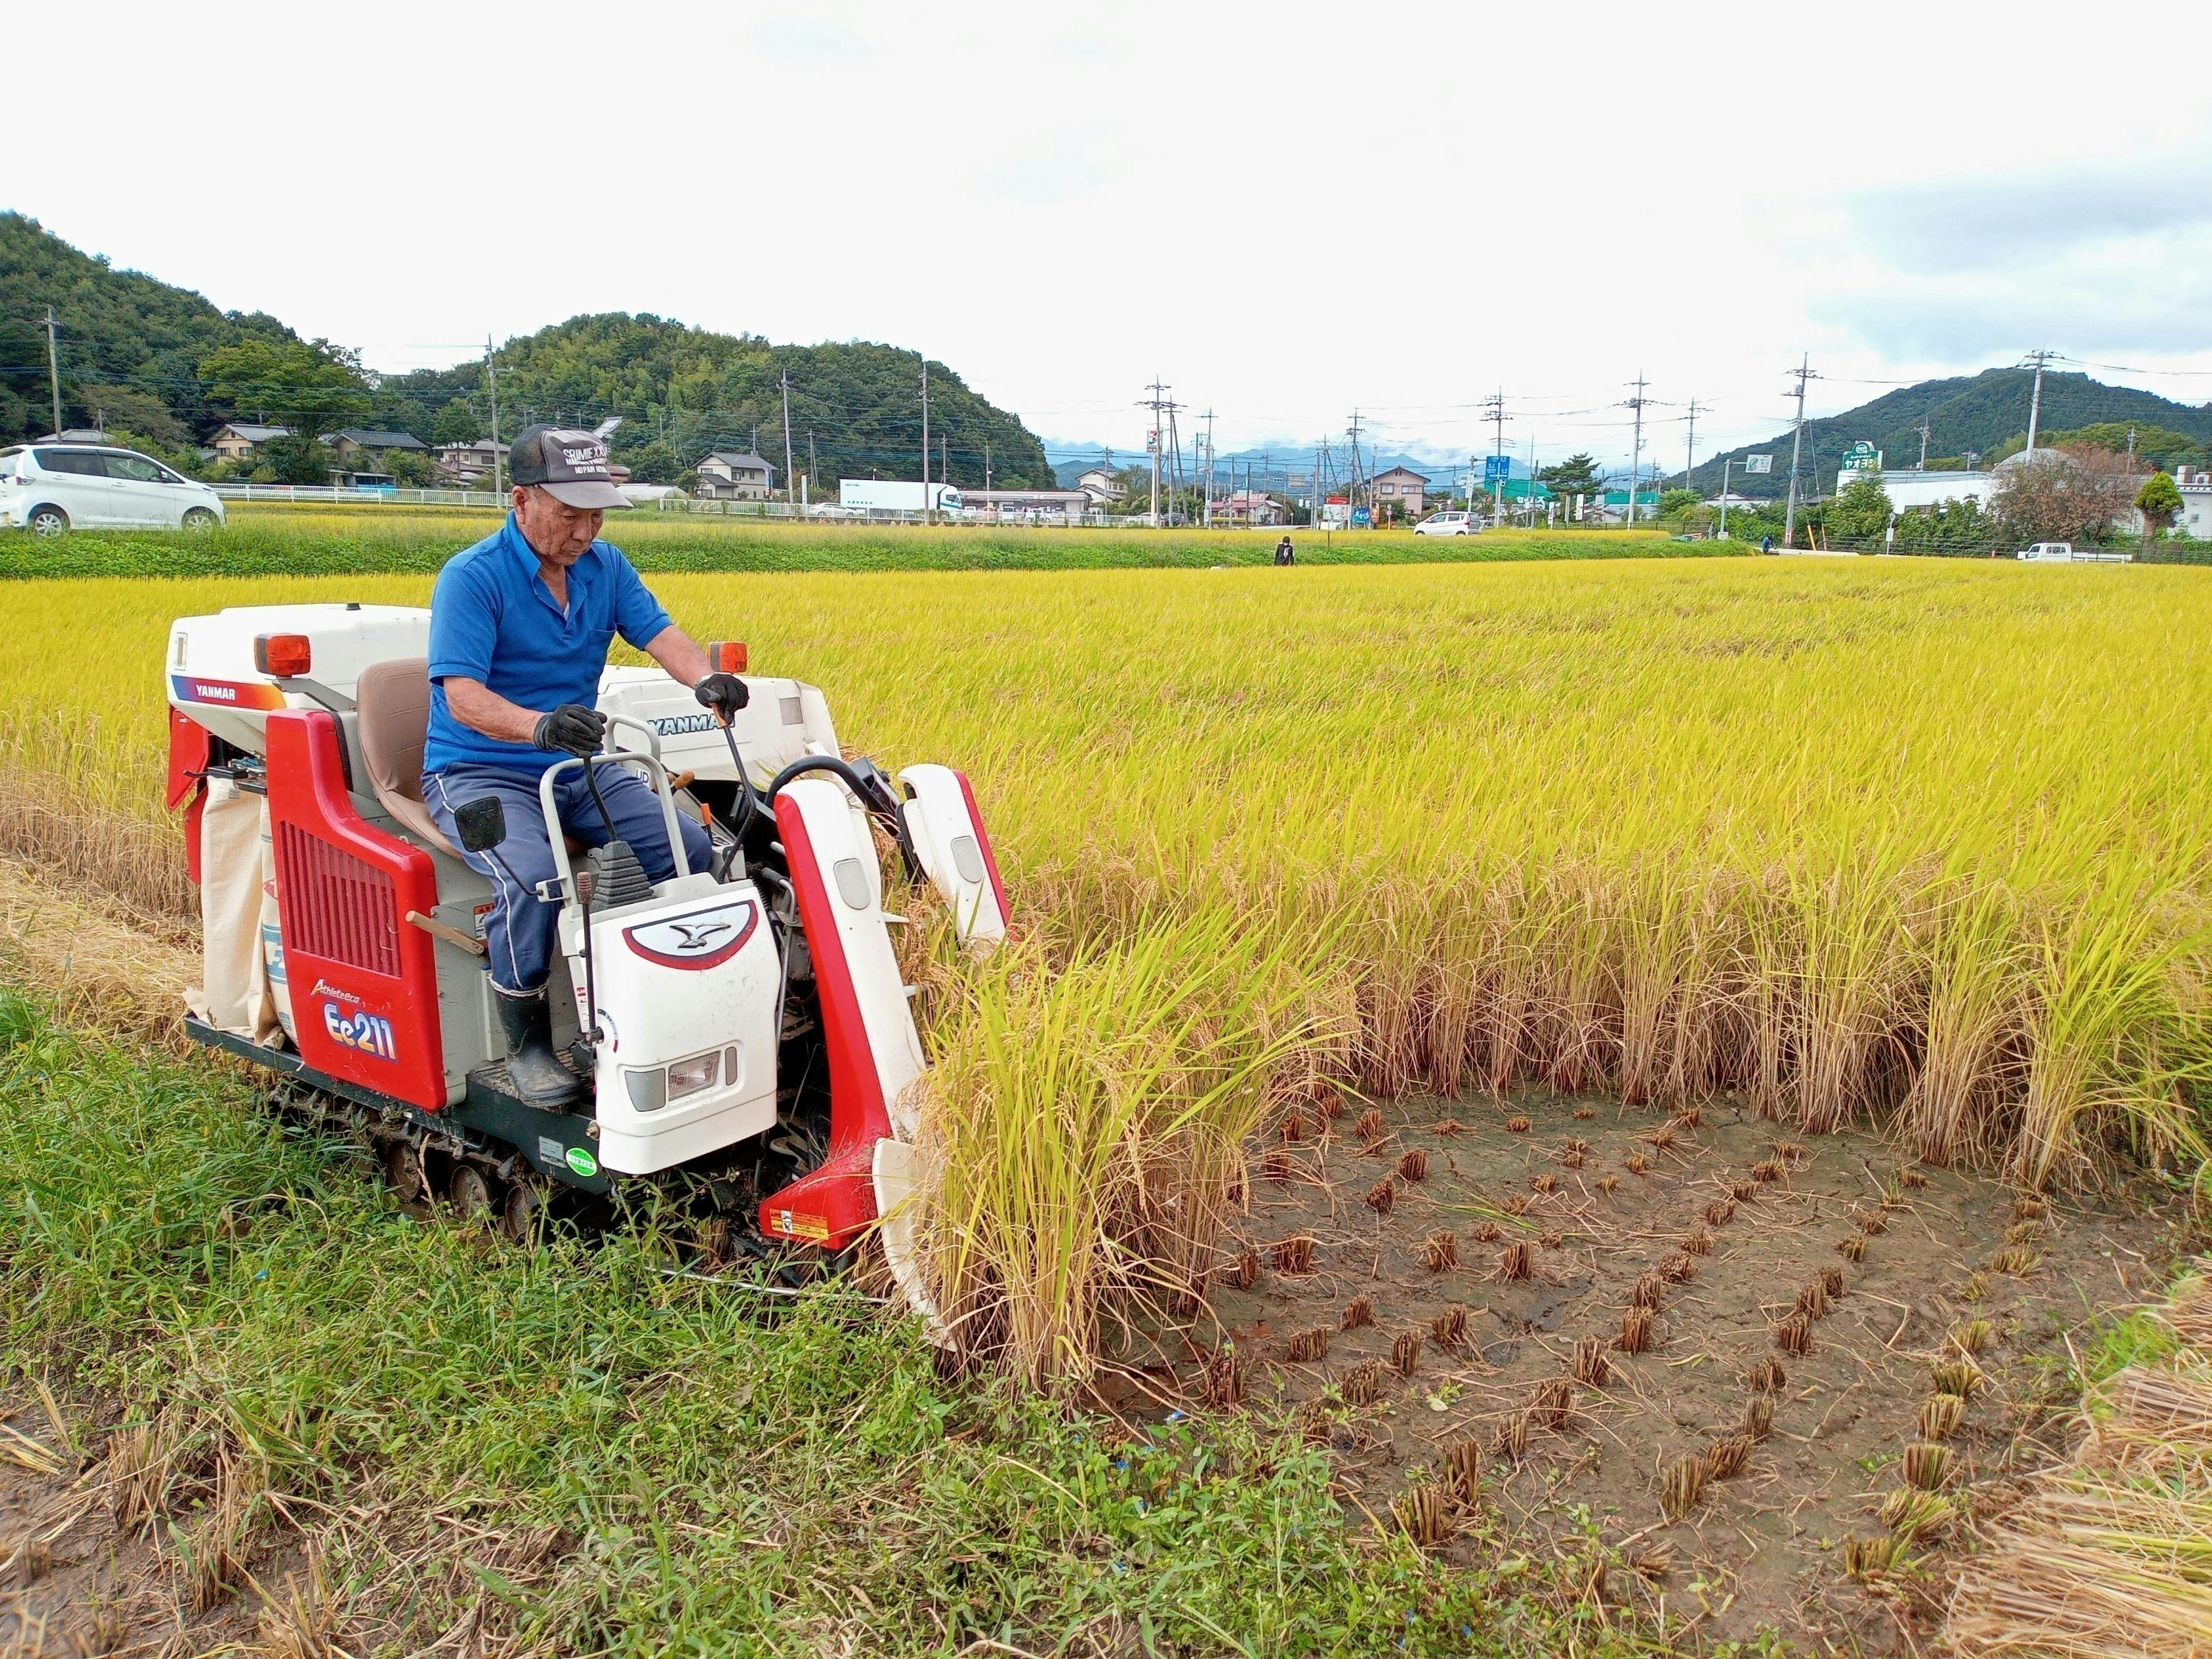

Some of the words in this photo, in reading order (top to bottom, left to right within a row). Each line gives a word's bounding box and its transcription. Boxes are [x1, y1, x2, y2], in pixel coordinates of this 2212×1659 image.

[195, 684, 236, 700] YANMAR
[647, 713, 736, 736] YANMA
[324, 1003, 397, 1060] Ee211
